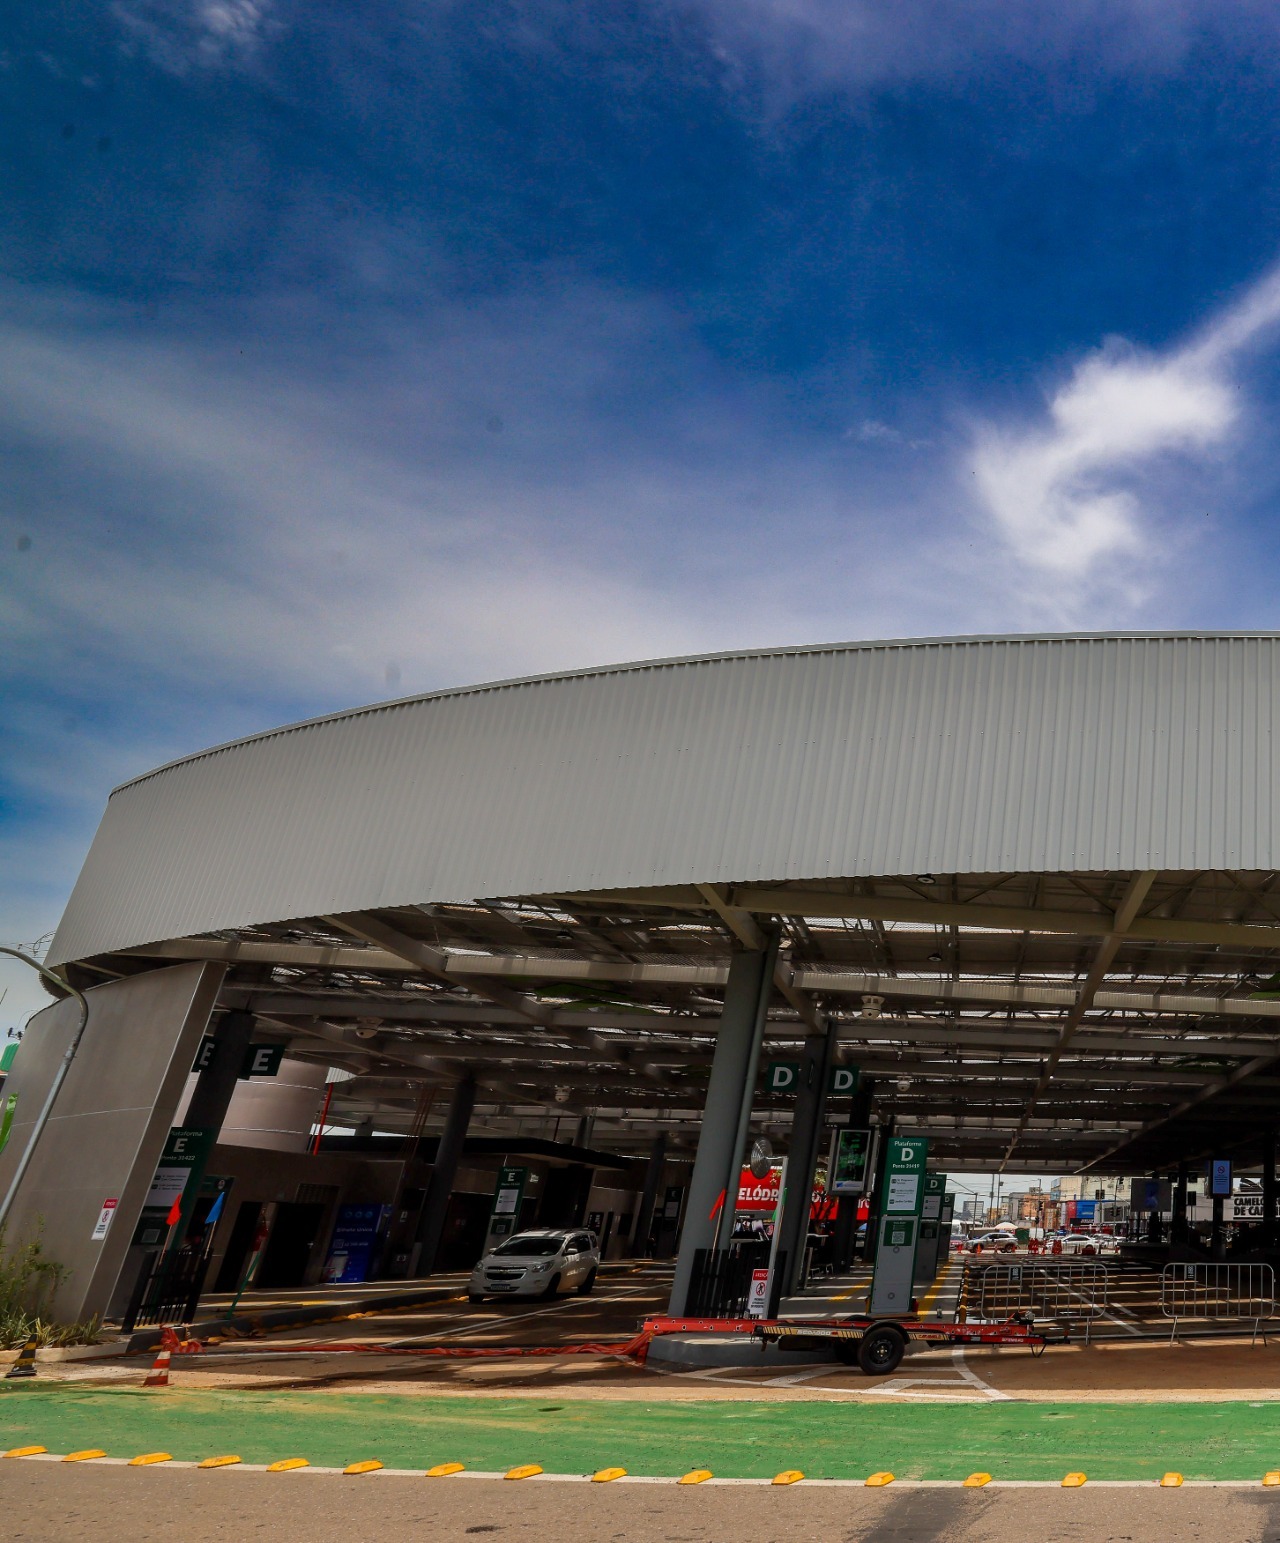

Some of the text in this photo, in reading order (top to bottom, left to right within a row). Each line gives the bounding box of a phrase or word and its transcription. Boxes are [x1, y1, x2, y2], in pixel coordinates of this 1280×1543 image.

[199, 1042, 215, 1066] E
[251, 1049, 274, 1071] E
[772, 1067, 794, 1087] D
[833, 1070, 854, 1090] D
[172, 1137, 188, 1152] E
[901, 1147, 914, 1161] D
[507, 1172, 515, 1181] E
[930, 1180, 938, 1188] D
[738, 1184, 779, 1202] ELÓDR
